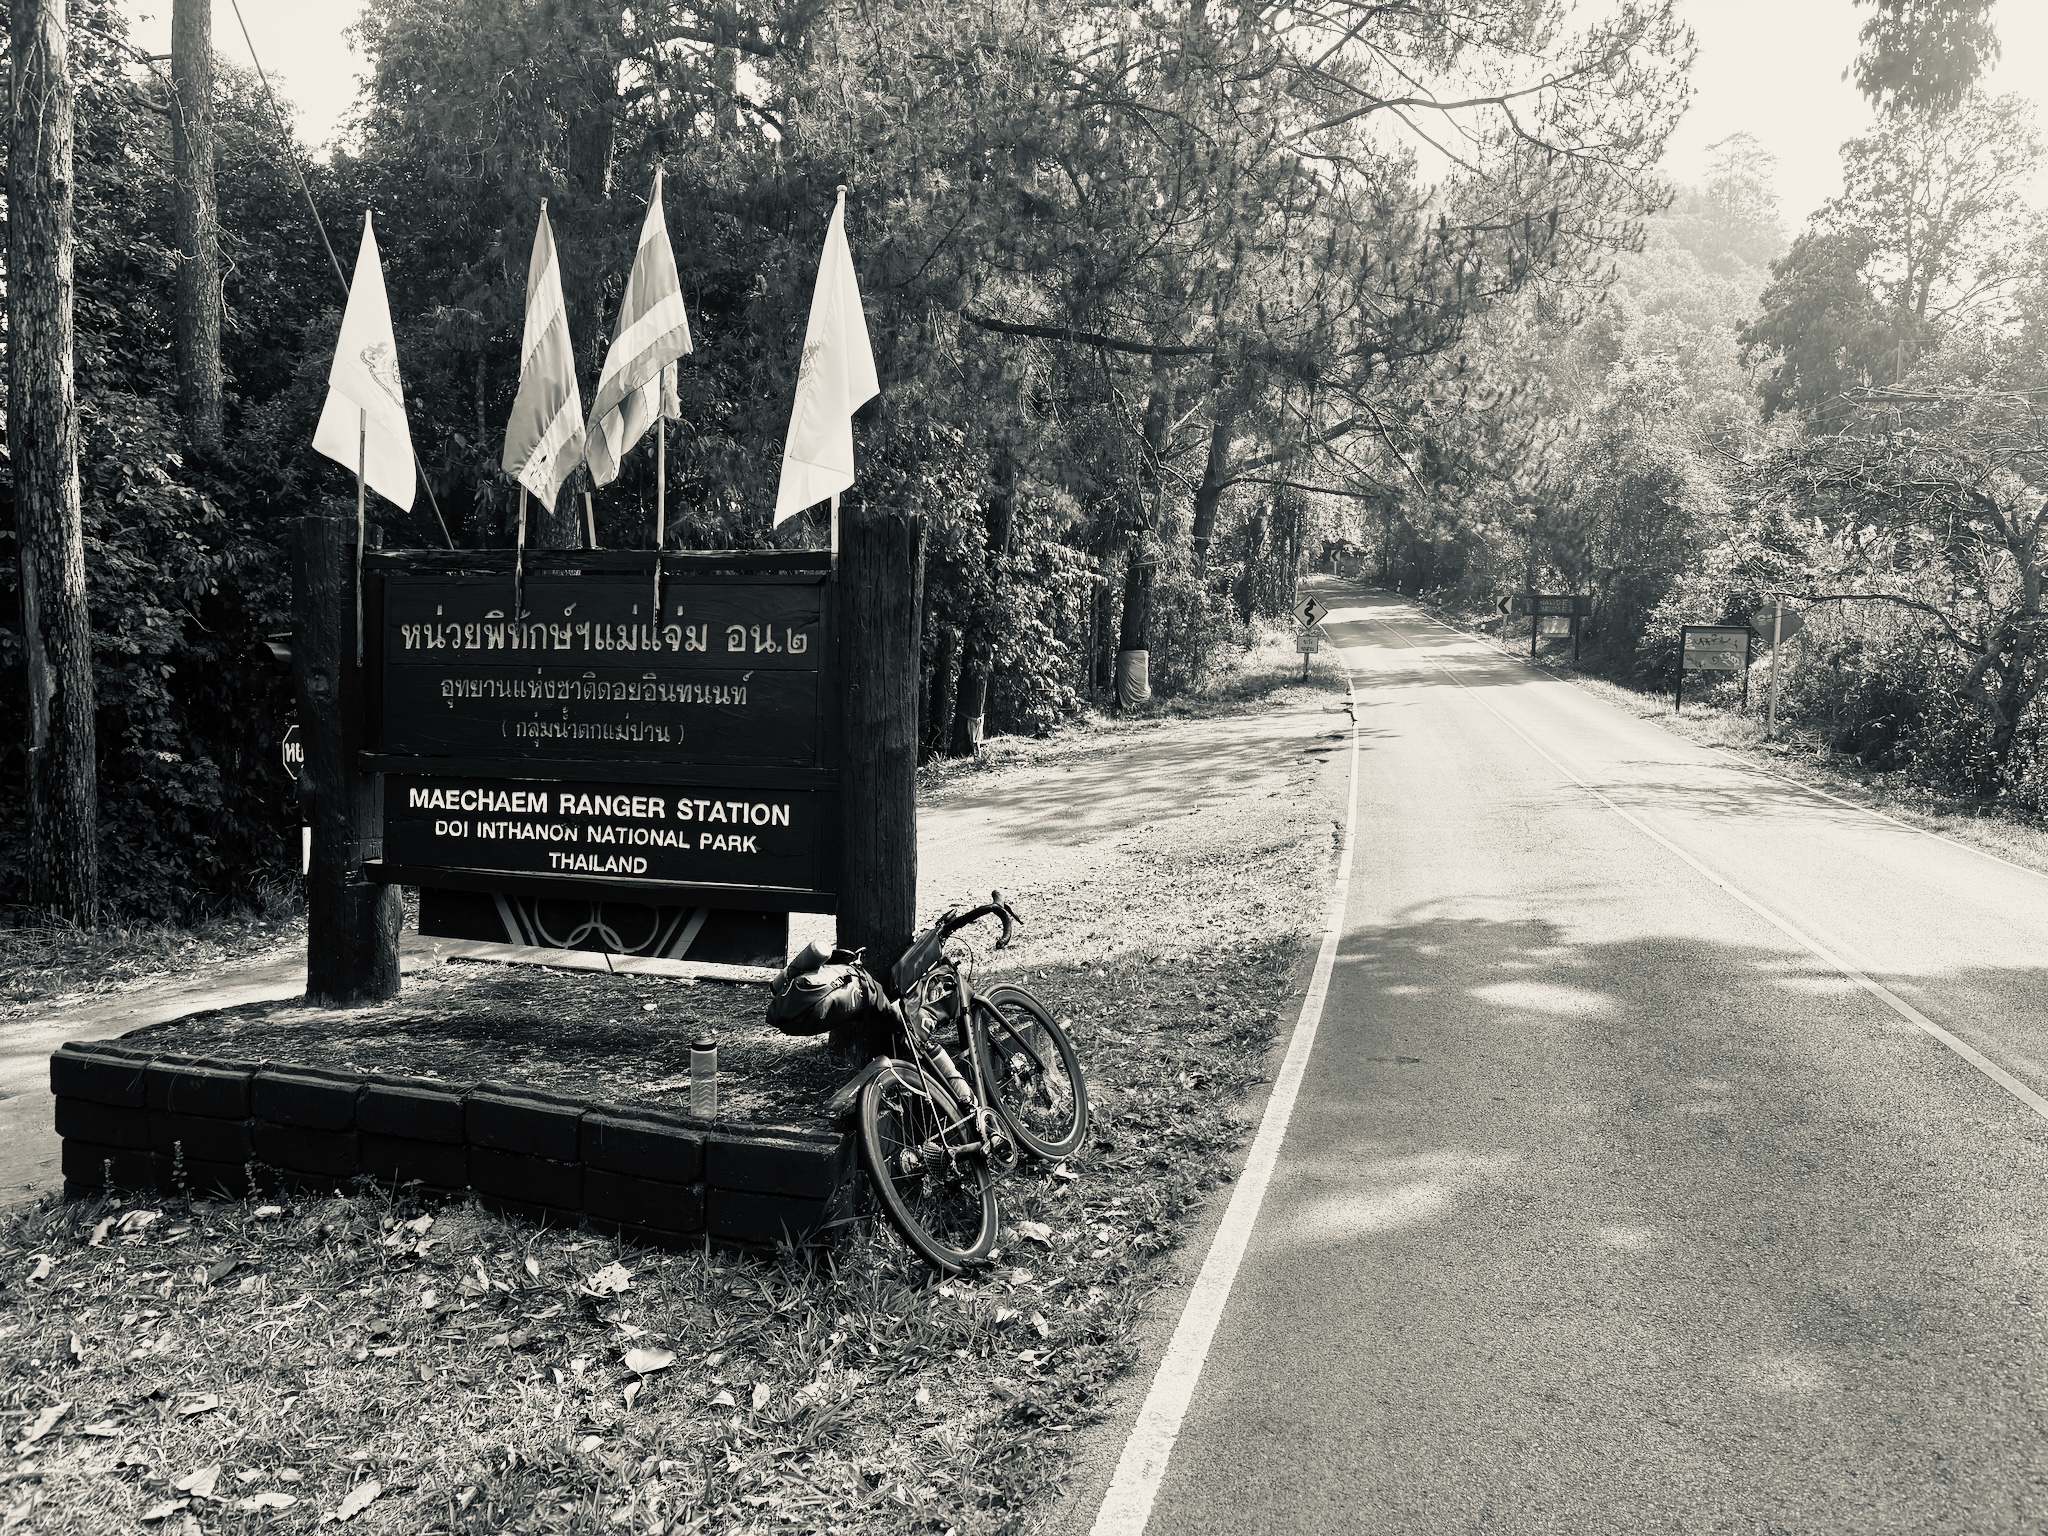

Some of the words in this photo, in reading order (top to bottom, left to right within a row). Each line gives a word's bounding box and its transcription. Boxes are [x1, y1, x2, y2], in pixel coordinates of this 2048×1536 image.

[440, 667, 753, 708] อุทยานแห่งชาติดอยอินทนนท์
[409, 788, 548, 814] MAECHAEM
[559, 794, 666, 819] RANGER
[676, 798, 790, 826] STATION
[435, 819, 469, 838] DOI
[477, 821, 578, 842] INTHANON
[587, 825, 691, 850] NATIONAL
[700, 833, 758, 853] PARK
[549, 852, 648, 874] THAILAND
